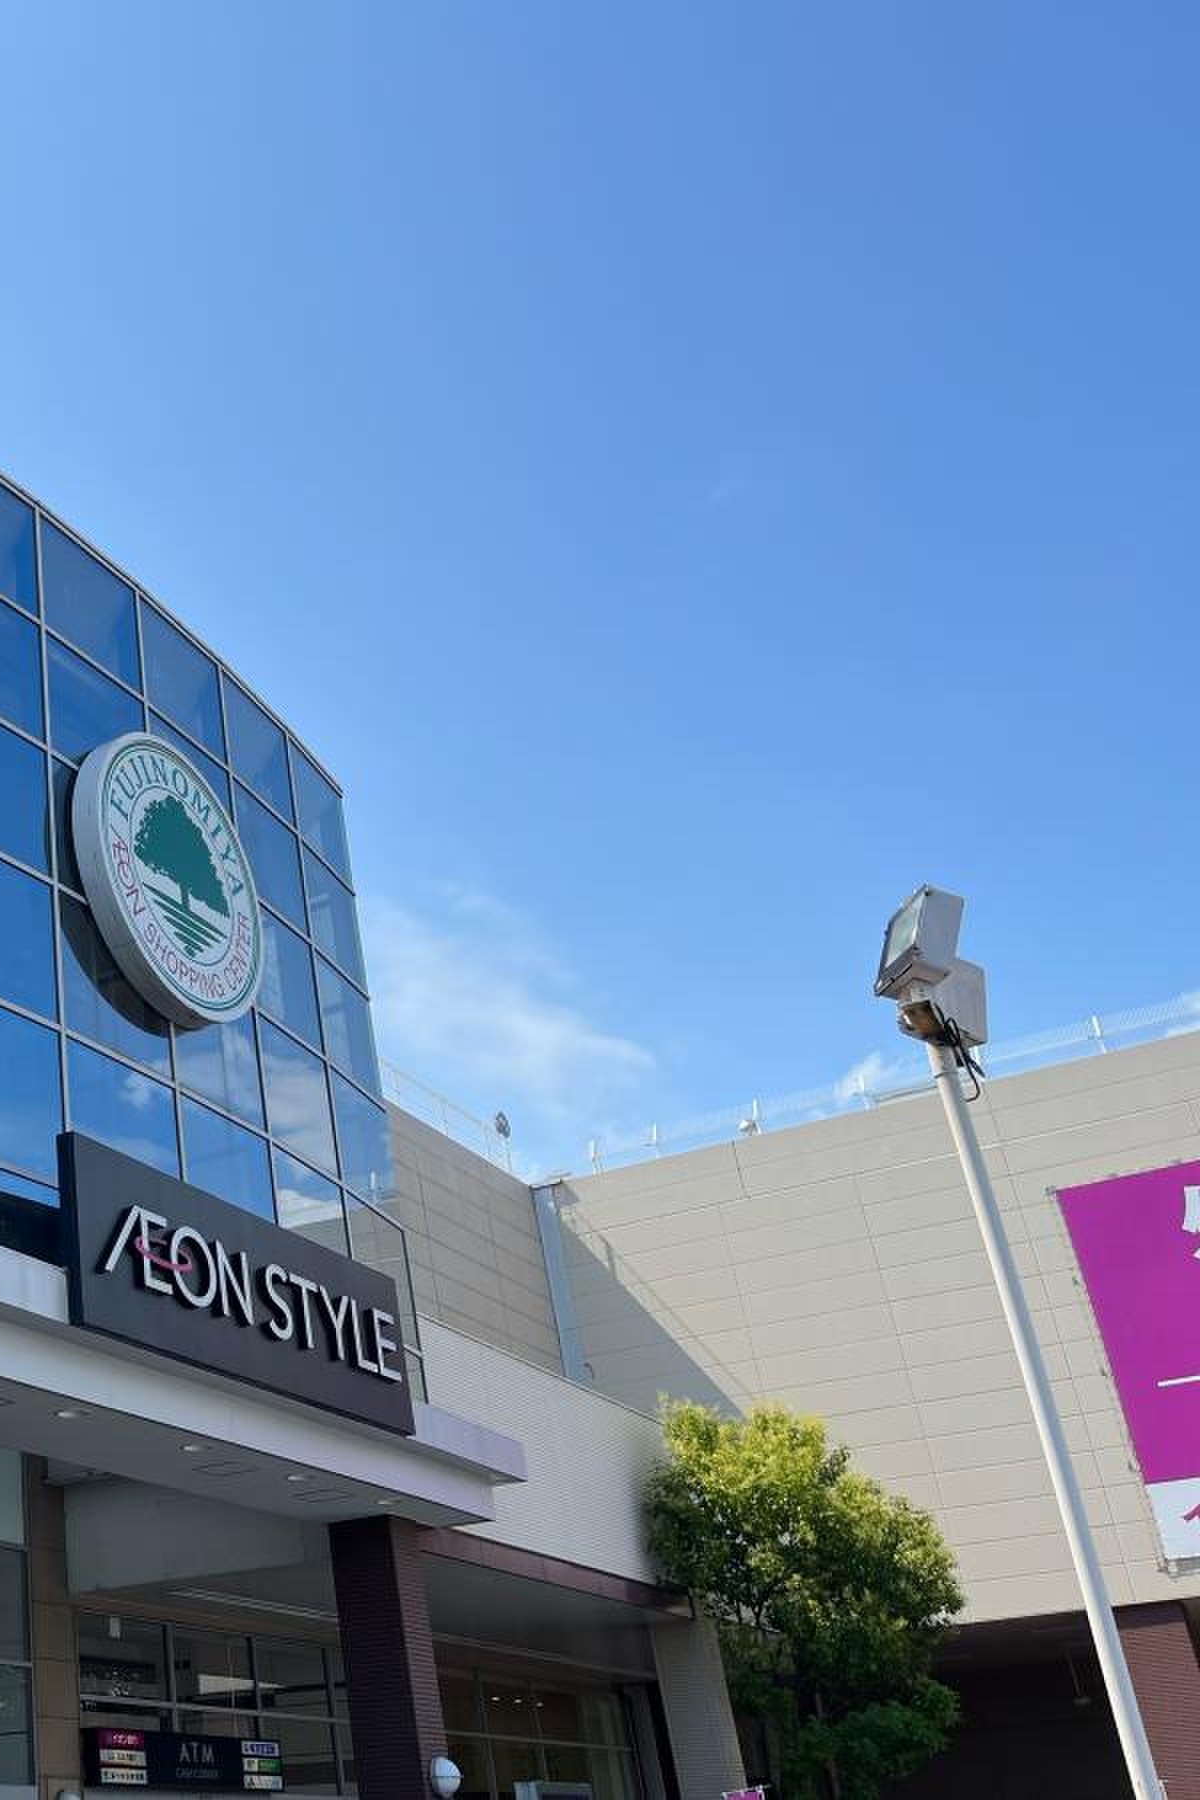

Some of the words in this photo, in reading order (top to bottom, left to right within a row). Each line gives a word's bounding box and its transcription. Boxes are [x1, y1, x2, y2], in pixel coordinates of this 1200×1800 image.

[111, 754, 244, 896] FUJINOMIYA
[142, 923, 226, 999] SHOPPING
[264, 1263, 402, 1382] STYLE
[179, 1742, 215, 1764] ATM
